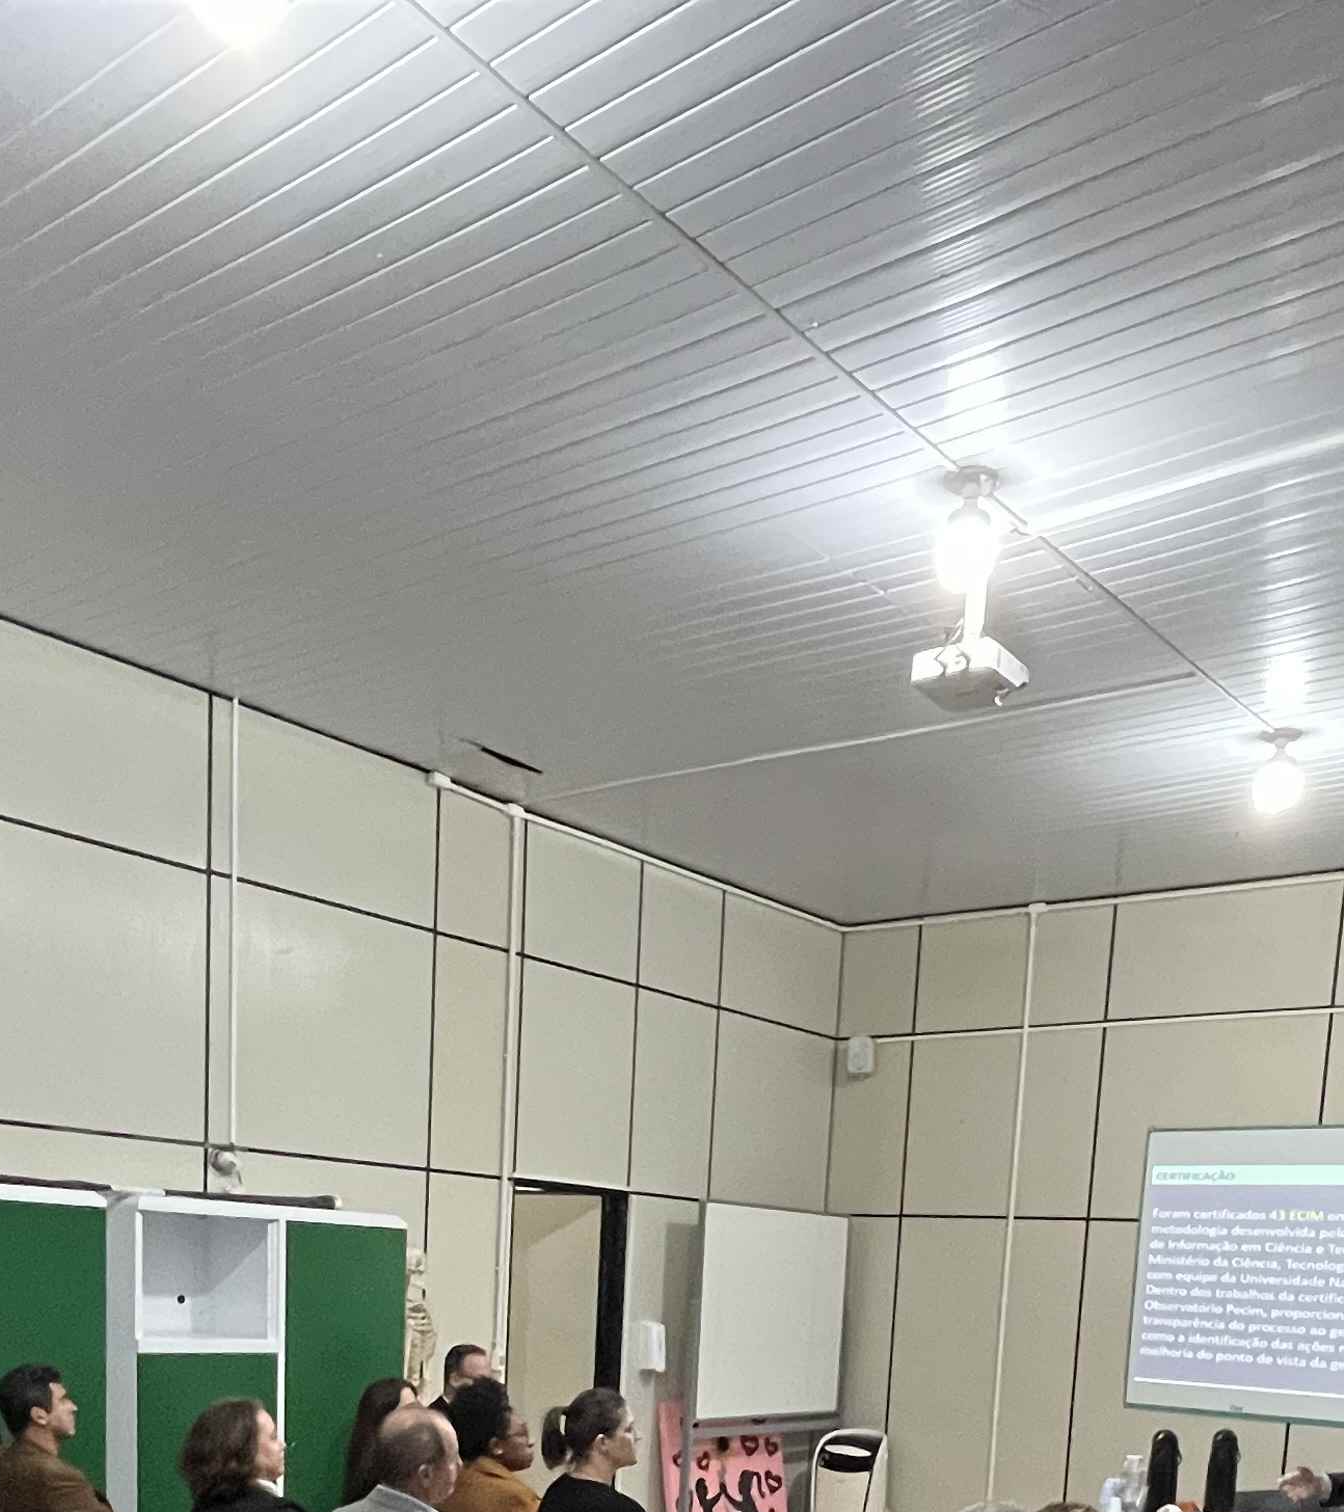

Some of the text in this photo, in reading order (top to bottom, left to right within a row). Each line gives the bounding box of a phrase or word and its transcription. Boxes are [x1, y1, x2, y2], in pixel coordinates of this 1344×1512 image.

[1156, 1170, 1236, 1182] CERTIFICAÇÃO
[1152, 1208, 1191, 1219] Foram
[1193, 1209, 1267, 1220] certificados
[1269, 1209, 1285, 1221] 43
[1288, 1210, 1324, 1222] ECIM
[1151, 1224, 1228, 1238] metodologia
[1230, 1226, 1316, 1238] desenvolvida
[1149, 1239, 1165, 1250] de
[1241, 1243, 1262, 1252] em
[1264, 1241, 1313, 1254] Ciência
[1315, 1245, 1325, 1254] e
[1148, 1254, 1210, 1266] Ministério
[1212, 1255, 1229, 1267] da
[1231, 1256, 1282, 1271] Ciência,
[1146, 1271, 1173, 1281] com
[1175, 1272, 1218, 1283] equipe
[1220, 1272, 1236, 1284] da
[1239, 1273, 1325, 1288] Universidade
[1146, 1284, 1187, 1296] Dentro
[1190, 1286, 1212, 1297] dos
[1215, 1287, 1275, 1301] trabalhos
[1277, 1290, 1295, 1302] da
[1144, 1299, 1223, 1314] Observatório
[1226, 1303, 1268, 1318] Pecim,
[1143, 1315, 1225, 1331] transparência
[1228, 1320, 1246, 1331] do
[1248, 1323, 1306, 1335] processo
[1309, 1327, 1327, 1336] ao
[1141, 1332, 1175, 1342] como
[1188, 1333, 1268, 1350] identificação
[1270, 1338, 1294, 1350] das
[1297, 1341, 1336, 1355] ações
[1139, 1346, 1193, 1358] melhoria
[1196, 1349, 1213, 1360] do
[1216, 1352, 1254, 1363] ponto
[1256, 1353, 1274, 1365] de
[1276, 1355, 1306, 1366] vista
[1309, 1357, 1327, 1369] da
